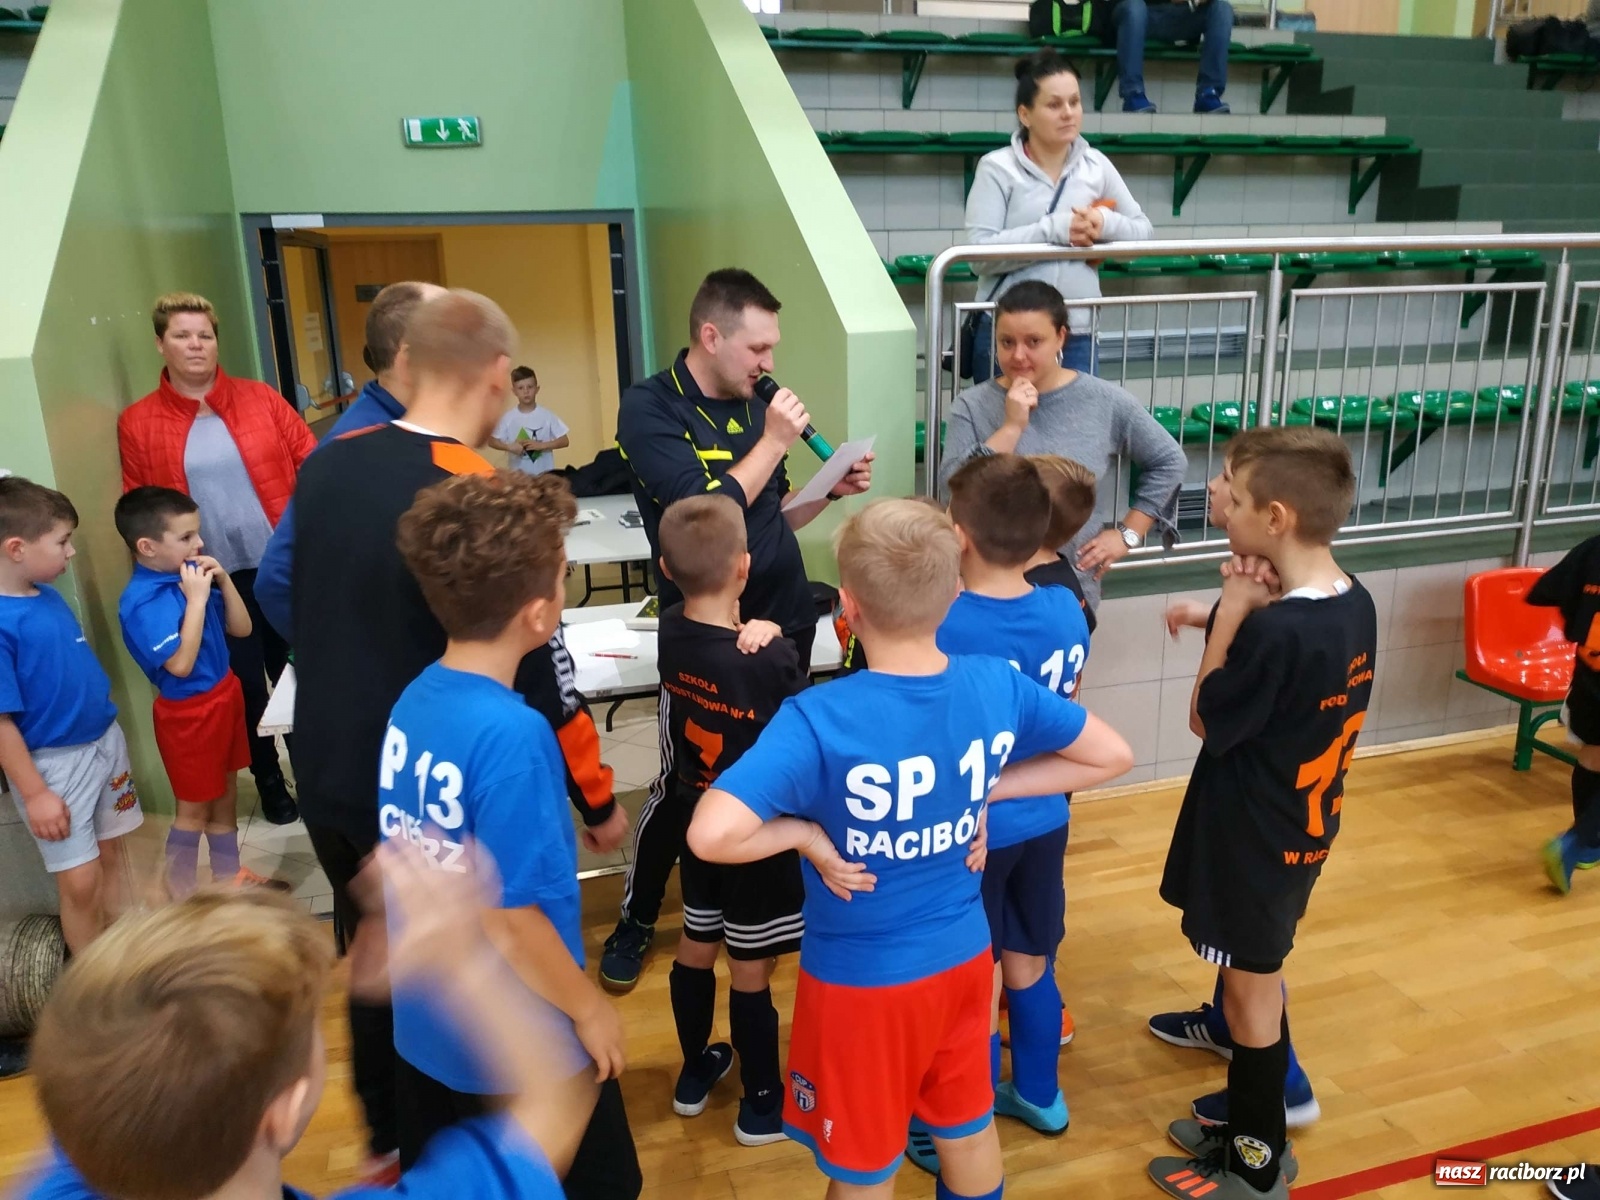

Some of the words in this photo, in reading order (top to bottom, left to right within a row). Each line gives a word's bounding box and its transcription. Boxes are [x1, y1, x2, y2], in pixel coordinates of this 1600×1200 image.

[678, 672, 719, 694] SZKOŁA
[730, 707, 745, 720] Nr
[747, 708, 755, 720] 4
[414, 750, 465, 830] 13
[845, 755, 936, 822] SP
[845, 802, 984, 861] RACIBÓ
[1283, 851, 1301, 865] W
